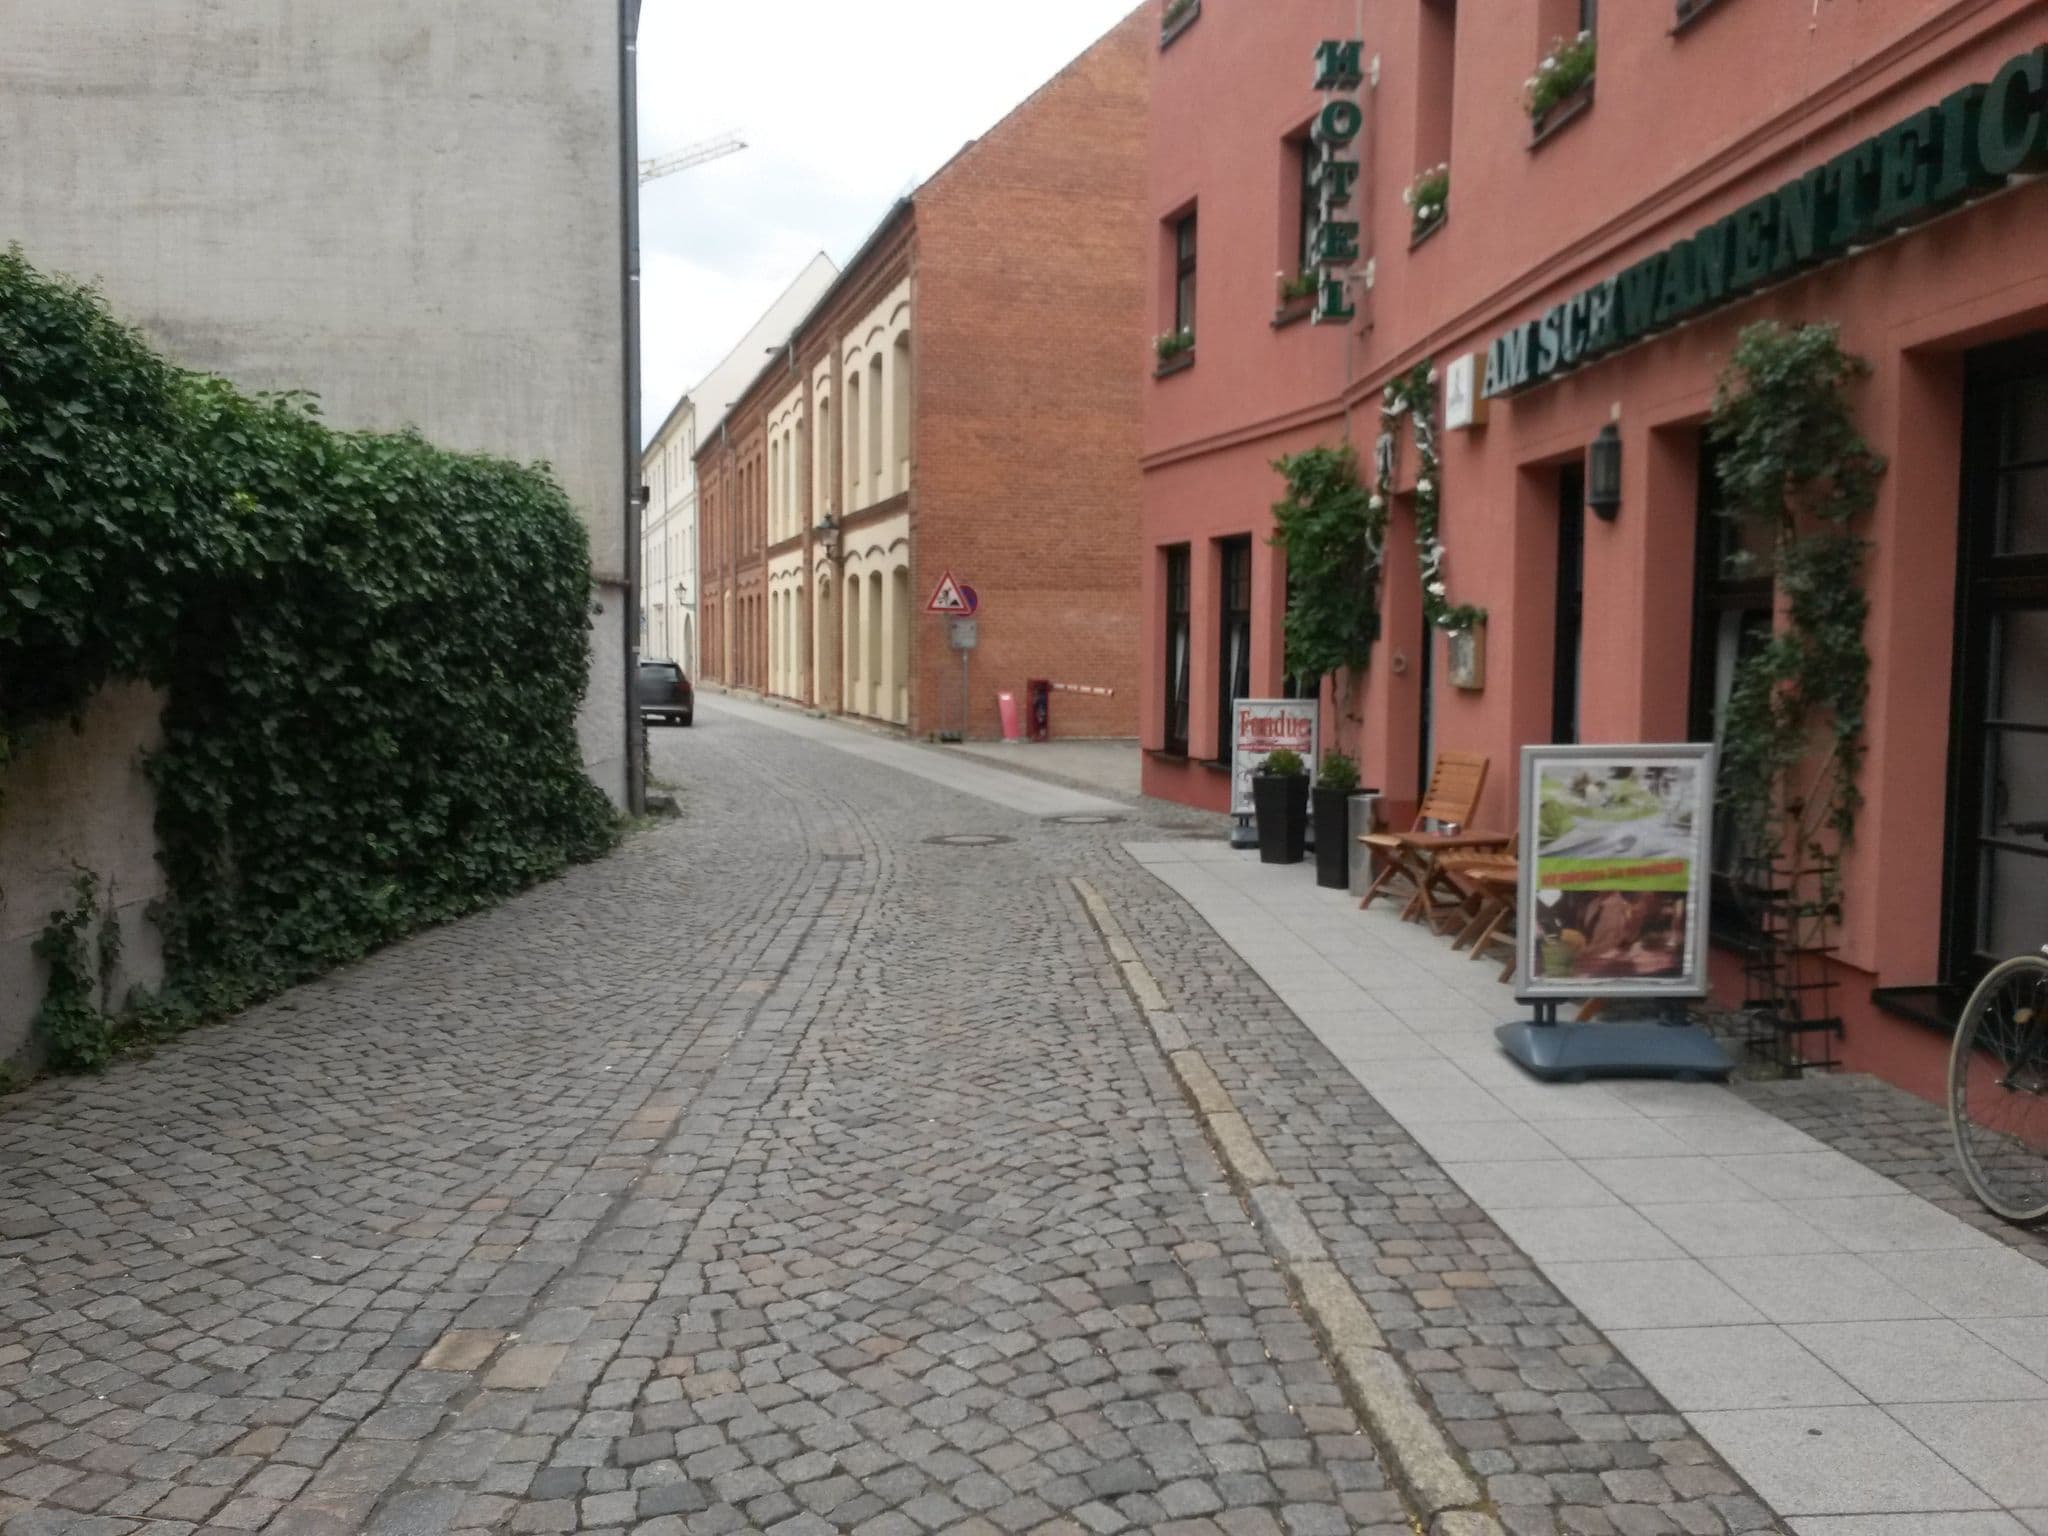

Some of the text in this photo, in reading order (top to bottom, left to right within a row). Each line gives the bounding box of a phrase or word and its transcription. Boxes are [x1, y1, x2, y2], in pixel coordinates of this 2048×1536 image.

[1314, 40, 1364, 322] HOTEL
[1481, 45, 2048, 398] AM SCHWANENTEIC
